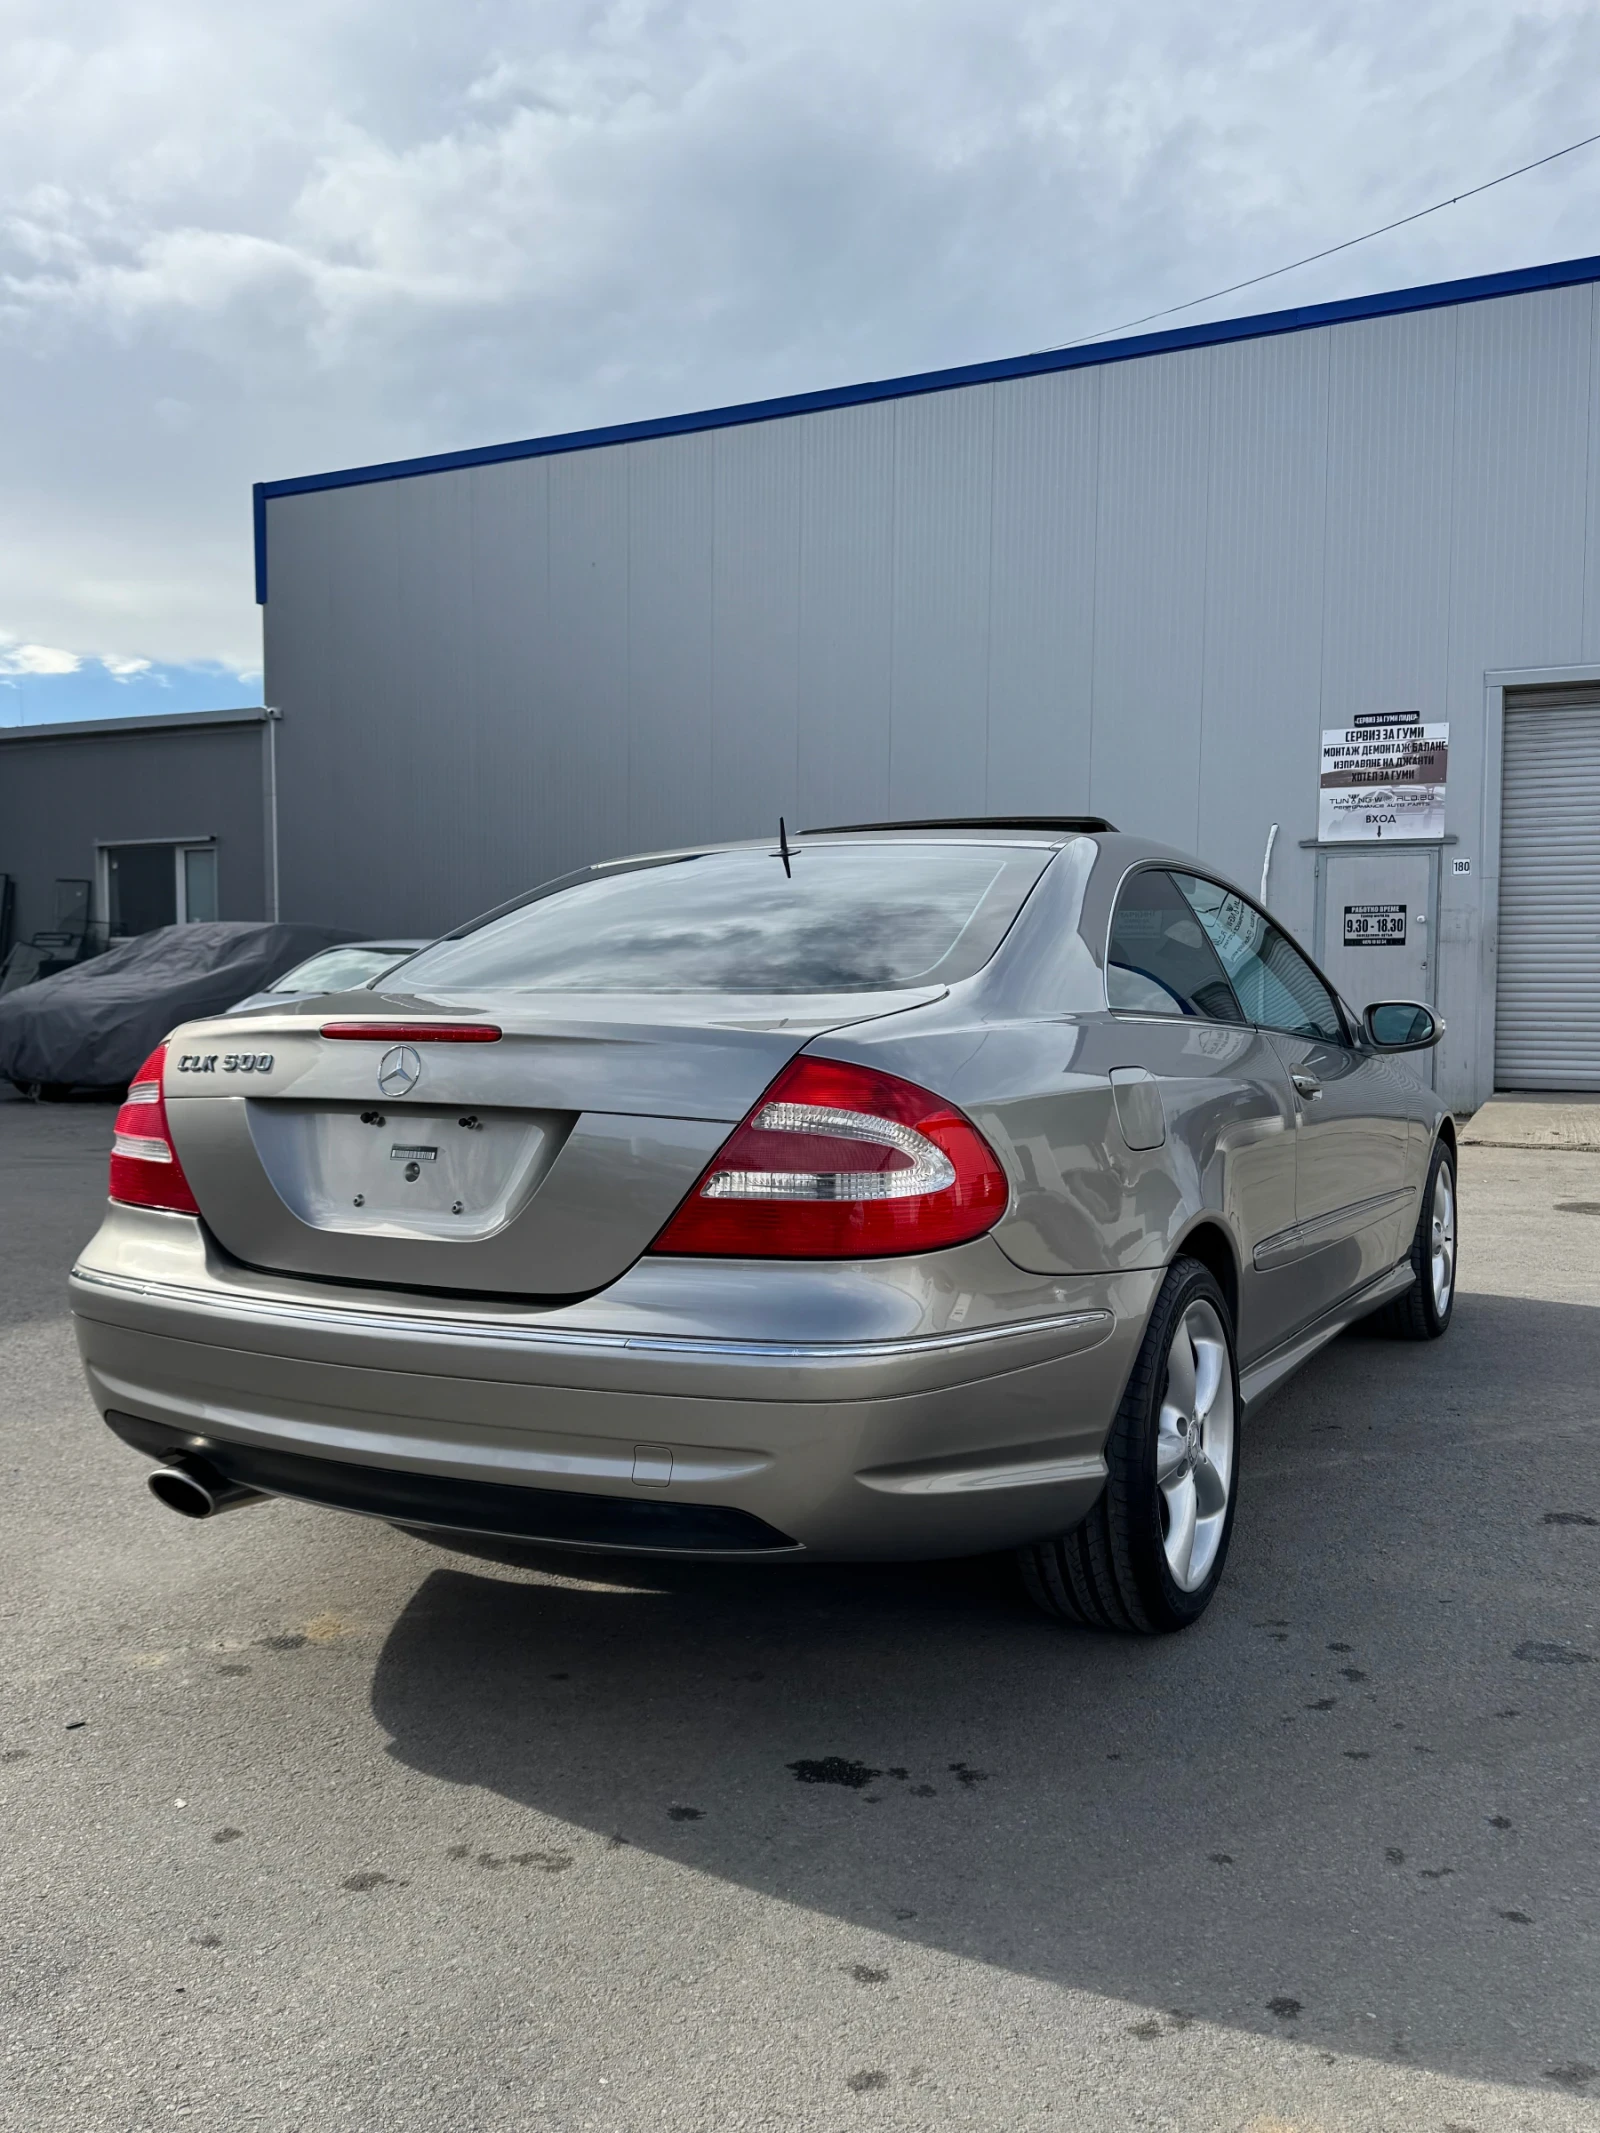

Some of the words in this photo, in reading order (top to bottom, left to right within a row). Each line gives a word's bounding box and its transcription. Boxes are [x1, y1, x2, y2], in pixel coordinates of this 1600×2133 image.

[1345, 729, 1382, 743] СЕРВИЗ
[1382, 728, 1395, 740] ЗА
[1396, 726, 1425, 739] ГУМИ
[1323, 746, 1360, 758] МОНТАЖ
[1361, 743, 1411, 756] ДЕМОНТАЖ
[1333, 758, 1382, 770] ИЗПРАВЯНЕ
[1382, 757, 1394, 767] НА
[1394, 755, 1435, 768] ДЖАНТИ
[1351, 772, 1378, 782] ХОТЕЛ
[1379, 771, 1391, 781] ЗА
[1390, 769, 1415, 780] ГУМИ
[1365, 814, 1396, 824] ВХОД
[1453, 861, 1470, 872] 180
[1346, 919, 1369, 933] 9.30
[1376, 918, 1404, 933] 18.30
[177, 1054, 219, 1072] CLK
[221, 1052, 275, 1073] 500
